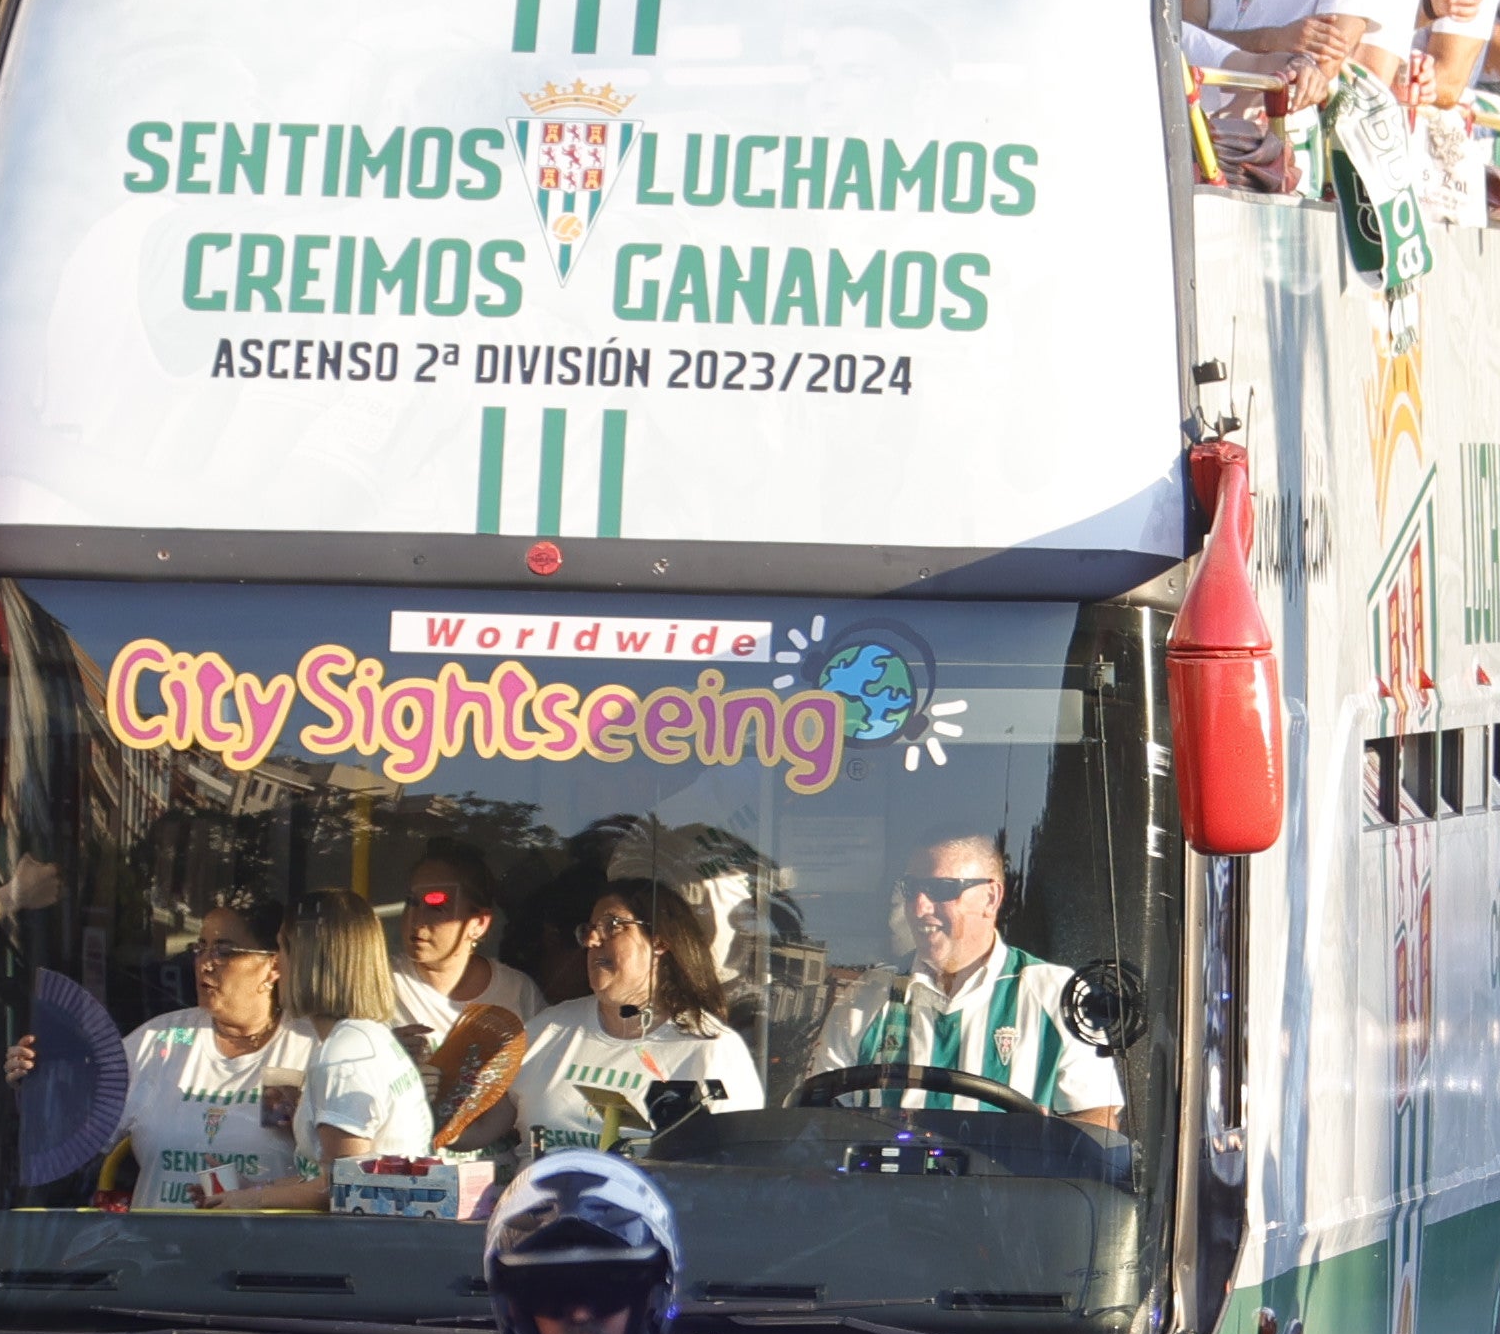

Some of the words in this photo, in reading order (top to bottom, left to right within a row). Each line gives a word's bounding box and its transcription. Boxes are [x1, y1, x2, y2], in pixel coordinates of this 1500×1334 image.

[124, 122, 502, 201] SENTIMOS
[635, 137, 1038, 217] LUCHAMOS
[182, 232, 524, 317] CREIMOS
[613, 243, 991, 332] GANAMOS
[212, 338, 396, 383] ASCENSO
[475, 337, 651, 389] DIVISIÓN
[667, 350, 913, 395] 2023/2024
[426, 615, 759, 658] Worldwide
[108, 638, 294, 771] City
[298, 644, 845, 795] Sightseeing
